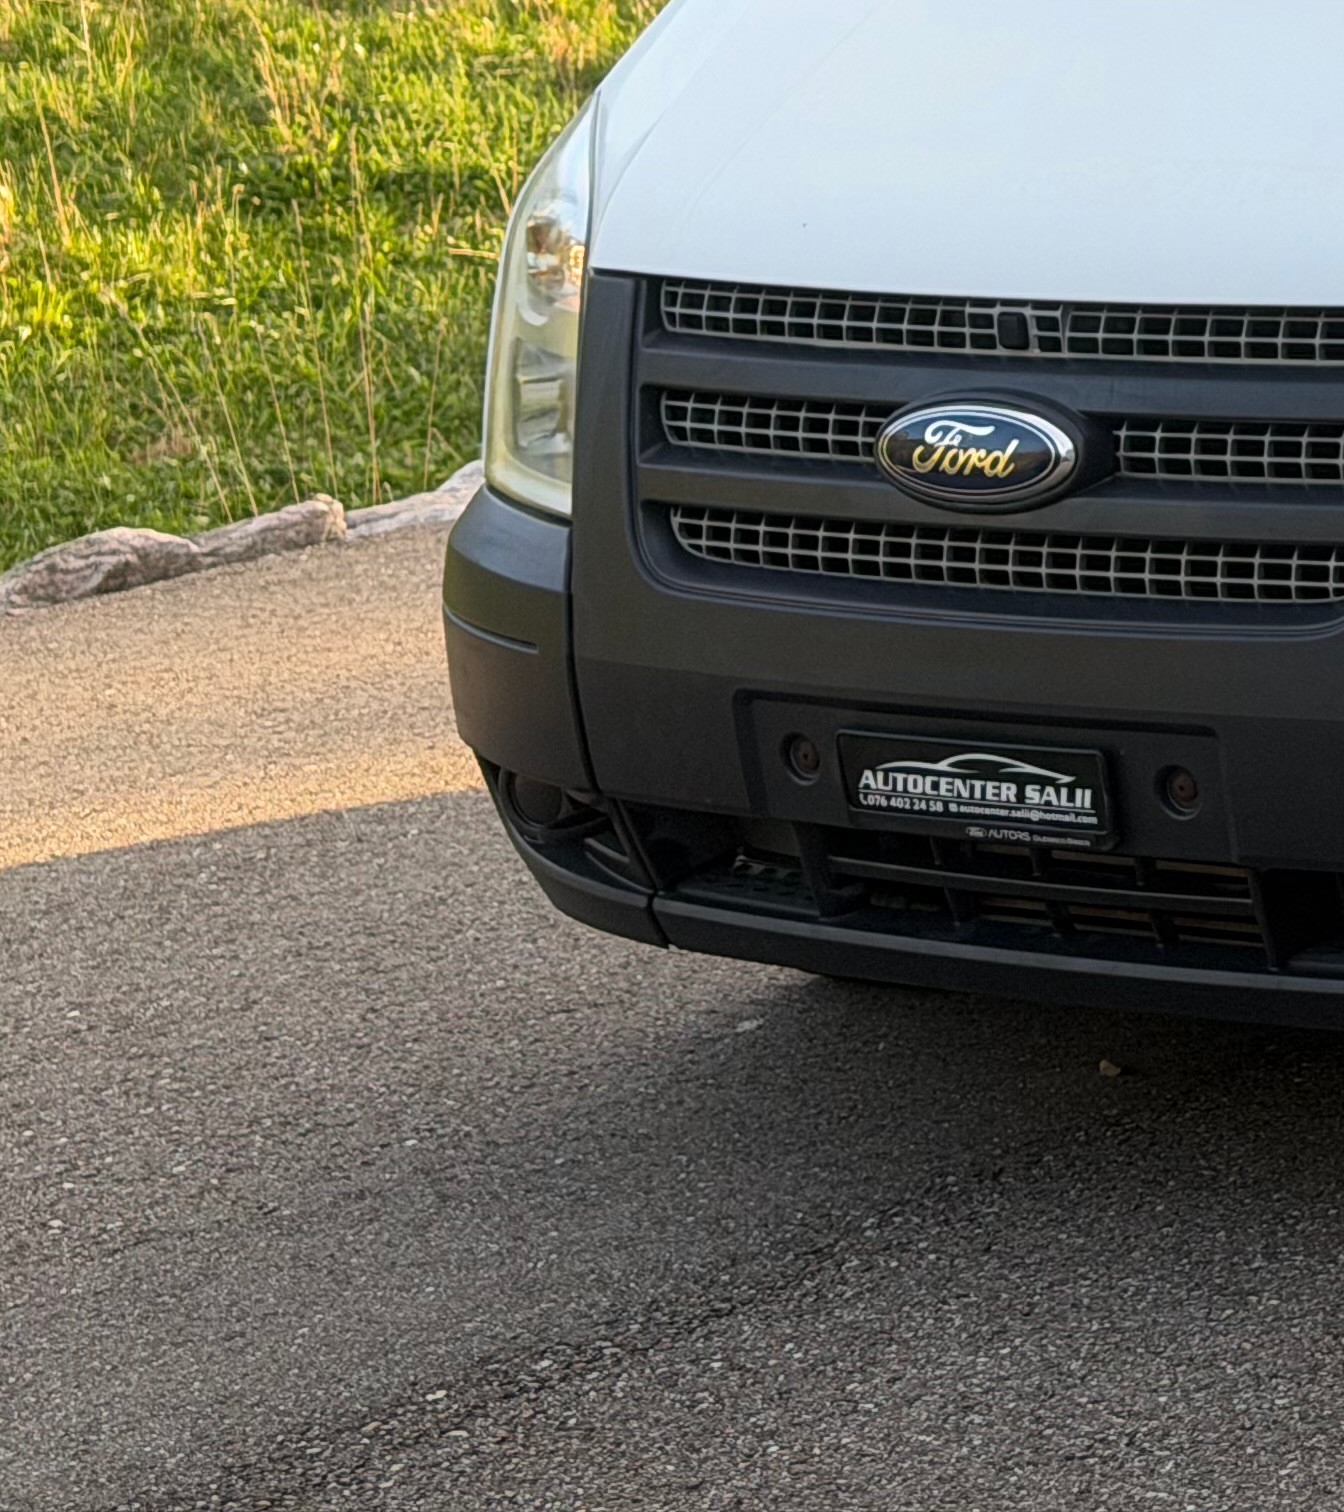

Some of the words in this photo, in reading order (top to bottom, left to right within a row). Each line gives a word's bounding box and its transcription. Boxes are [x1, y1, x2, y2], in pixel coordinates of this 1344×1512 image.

[911, 419, 1020, 478] Ford
[858, 768, 1018, 803] AUTOCENTER
[1024, 783, 1093, 809] SALII
[867, 794, 888, 808] 076
[890, 796, 912, 810] 402
[912, 799, 928, 811] 24
